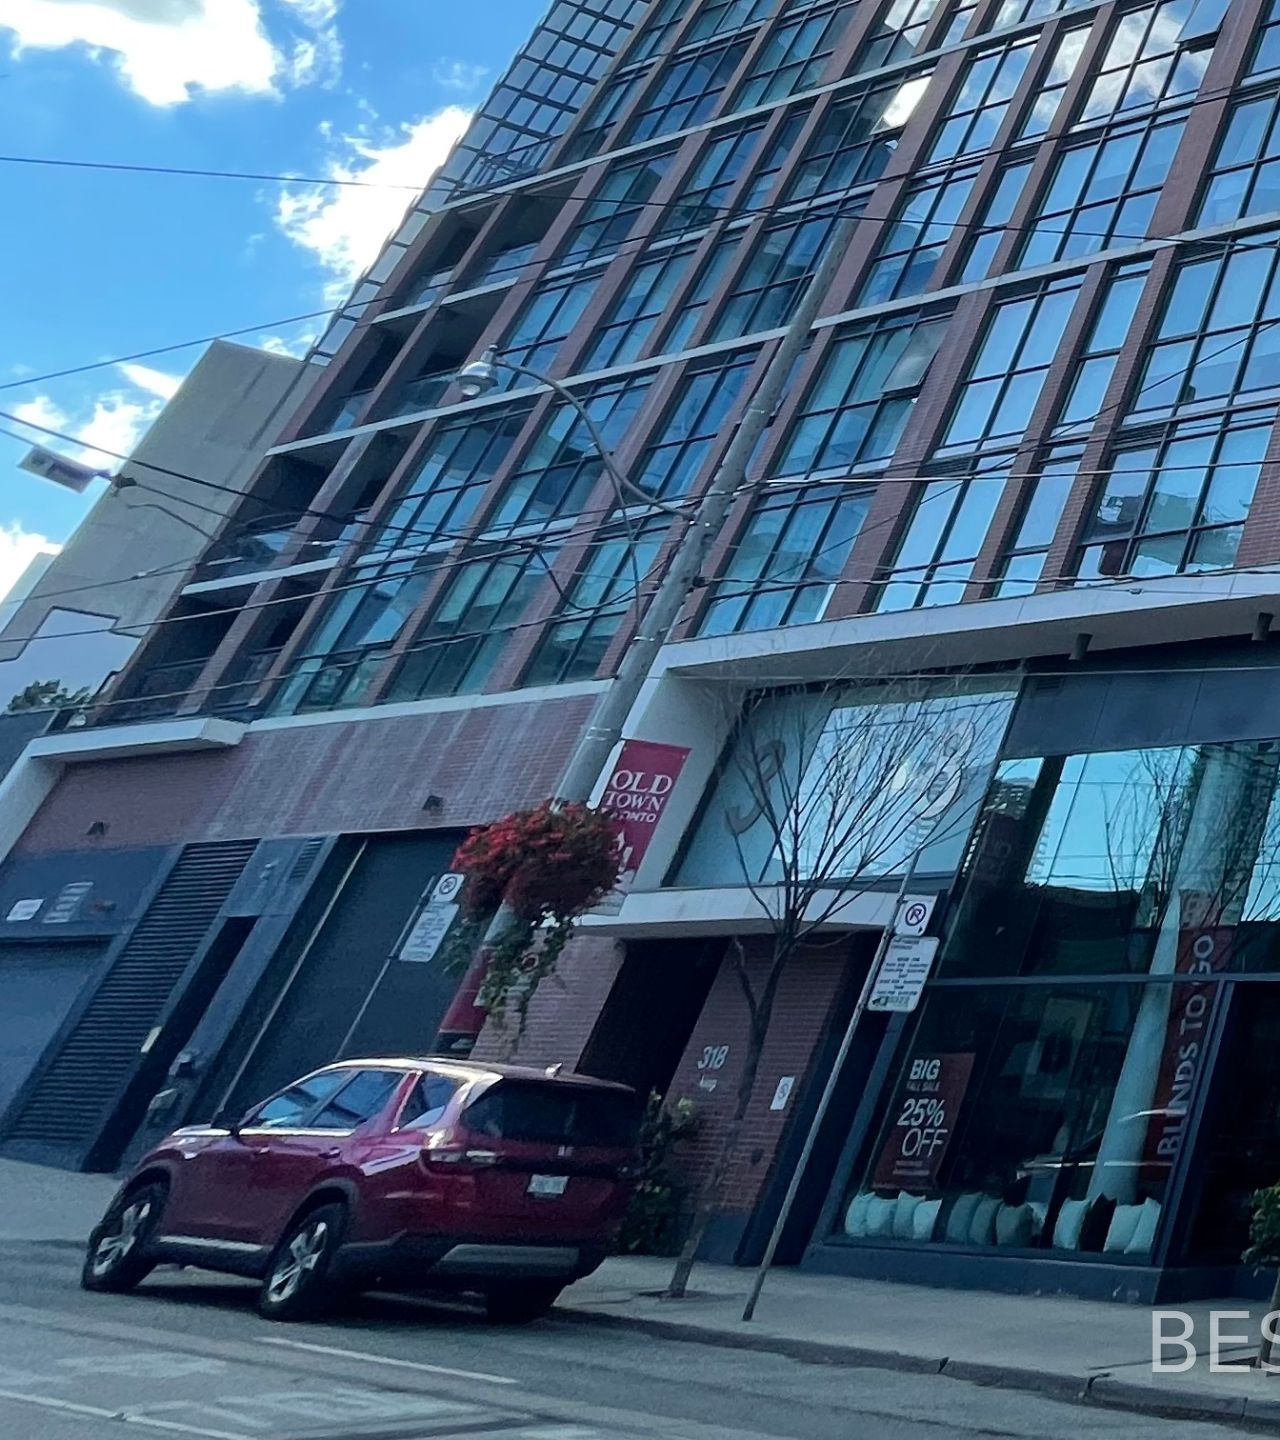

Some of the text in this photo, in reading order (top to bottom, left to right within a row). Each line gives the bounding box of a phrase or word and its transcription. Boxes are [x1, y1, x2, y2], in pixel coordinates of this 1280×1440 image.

[611, 769, 673, 795] OLD
[606, 790, 665, 812] TOWN
[601, 808, 657, 823] ONTO
[697, 1045, 729, 1070] 318
[909, 1059, 941, 1080] BIG
[1157, 1041, 1199, 1156] BLINDS
[1179, 994, 1207, 1037] TO
[897, 1098, 946, 1127] 25%
[901, 1127, 949, 1158] OFF
